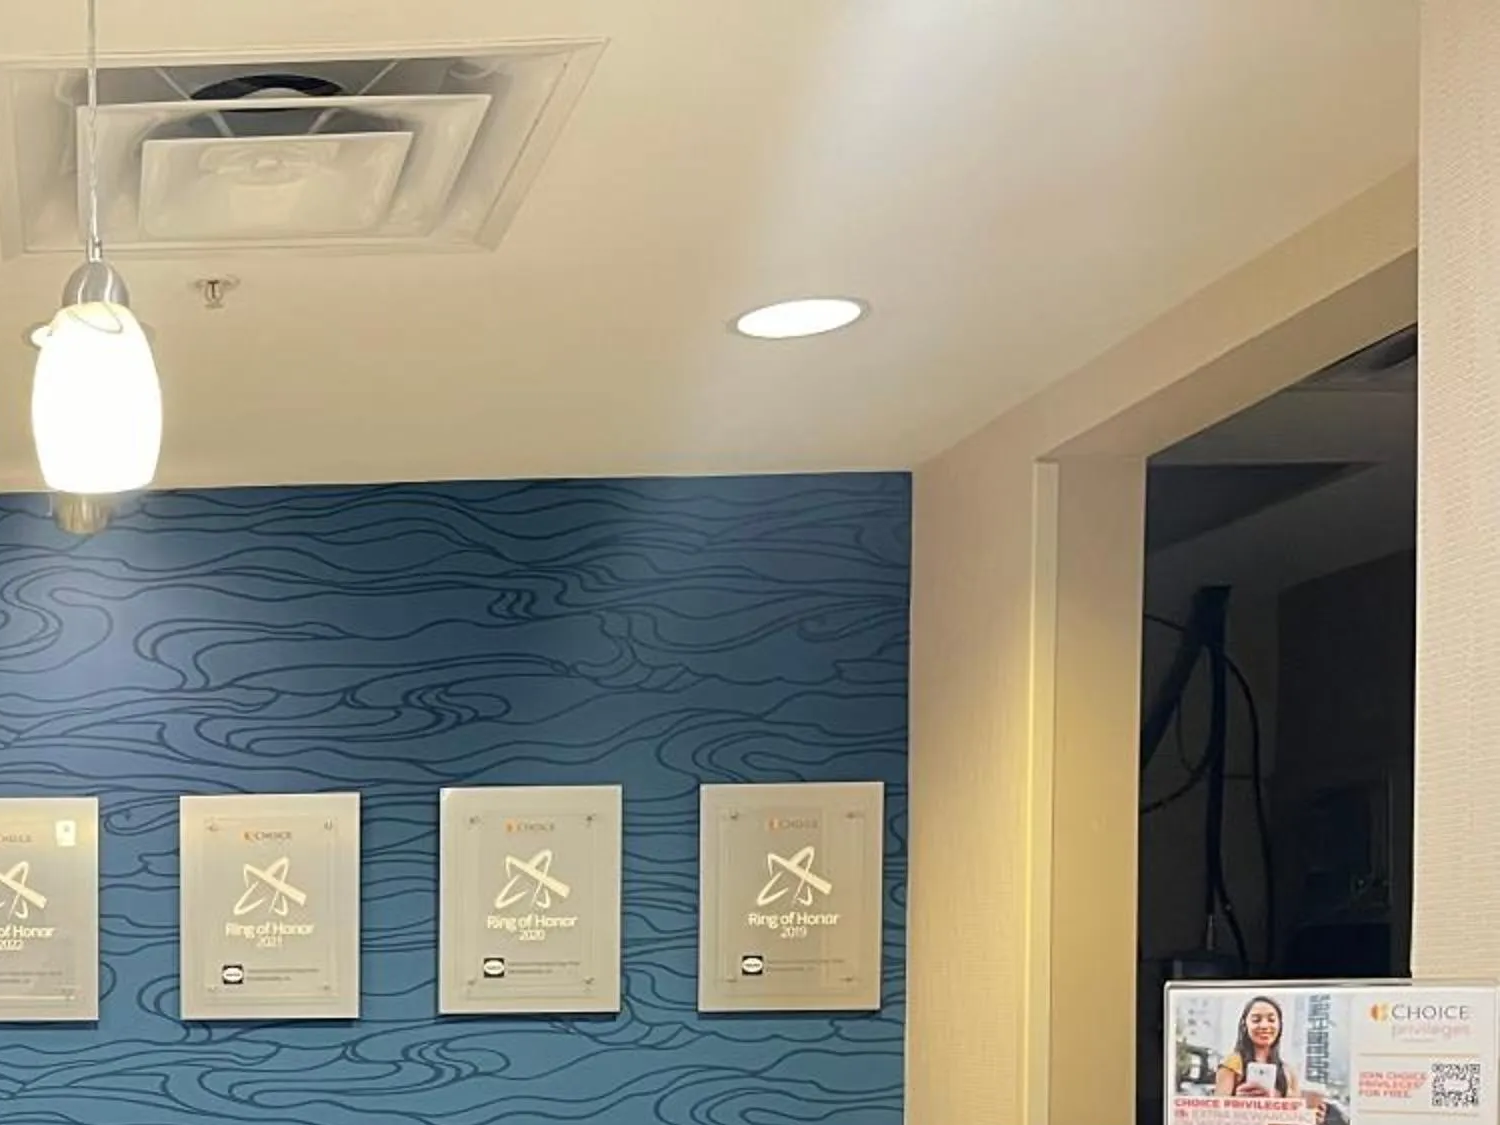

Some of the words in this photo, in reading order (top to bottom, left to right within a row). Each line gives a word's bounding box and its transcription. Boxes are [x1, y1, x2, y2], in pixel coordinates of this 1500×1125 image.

[487, 915, 517, 933] Ring
[518, 913, 533, 927] of
[535, 914, 578, 927] Honor
[748, 912, 779, 929] Ring
[780, 911, 795, 925] of
[797, 912, 841, 925] Honor
[13, 925, 56, 938] Honor
[225, 922, 255, 939] Ring
[256, 921, 271, 935] of
[272, 921, 315, 935] Honor
[519, 929, 546, 941] 2020
[780, 926, 807, 939] 2019
[1390, 1003, 1470, 1022] CHOICE
[1359, 1071, 1384, 1080] JOIN
[1386, 1071, 1428, 1080] CHOICE
[1358, 1089, 1381, 1098] FOR
[1174, 1098, 1221, 1109] CHOICE
